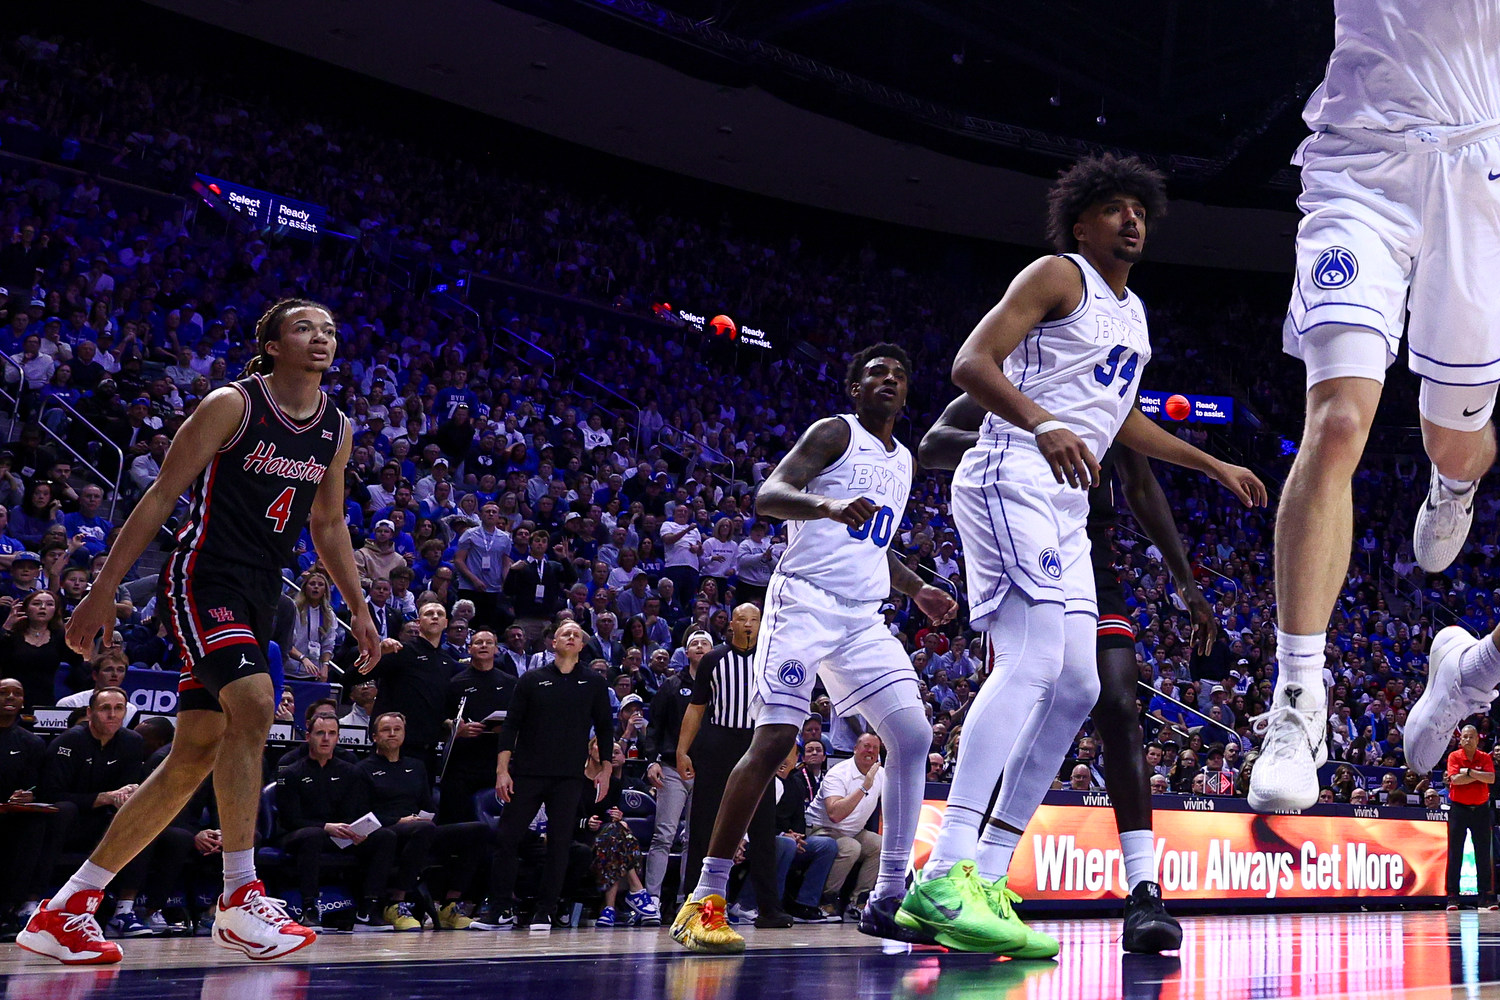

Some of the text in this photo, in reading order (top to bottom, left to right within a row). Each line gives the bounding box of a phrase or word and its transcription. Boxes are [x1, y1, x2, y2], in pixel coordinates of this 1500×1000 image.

[228, 192, 260, 207] Select
[279, 205, 309, 221] Ready
[278, 215, 317, 233] to assist.
[680, 310, 705, 324] Select
[742, 326, 765, 339] Ready
[1094, 344, 1138, 398] 34
[1196, 402, 1217, 411] Ready
[243, 440, 327, 484] Houston
[848, 464, 907, 509] BYU
[265, 486, 296, 533] 4
[1153, 838, 1197, 890] You
[1205, 839, 1294, 899] Always
[1301, 841, 1343, 890] Get
[1345, 842, 1404, 890] More
